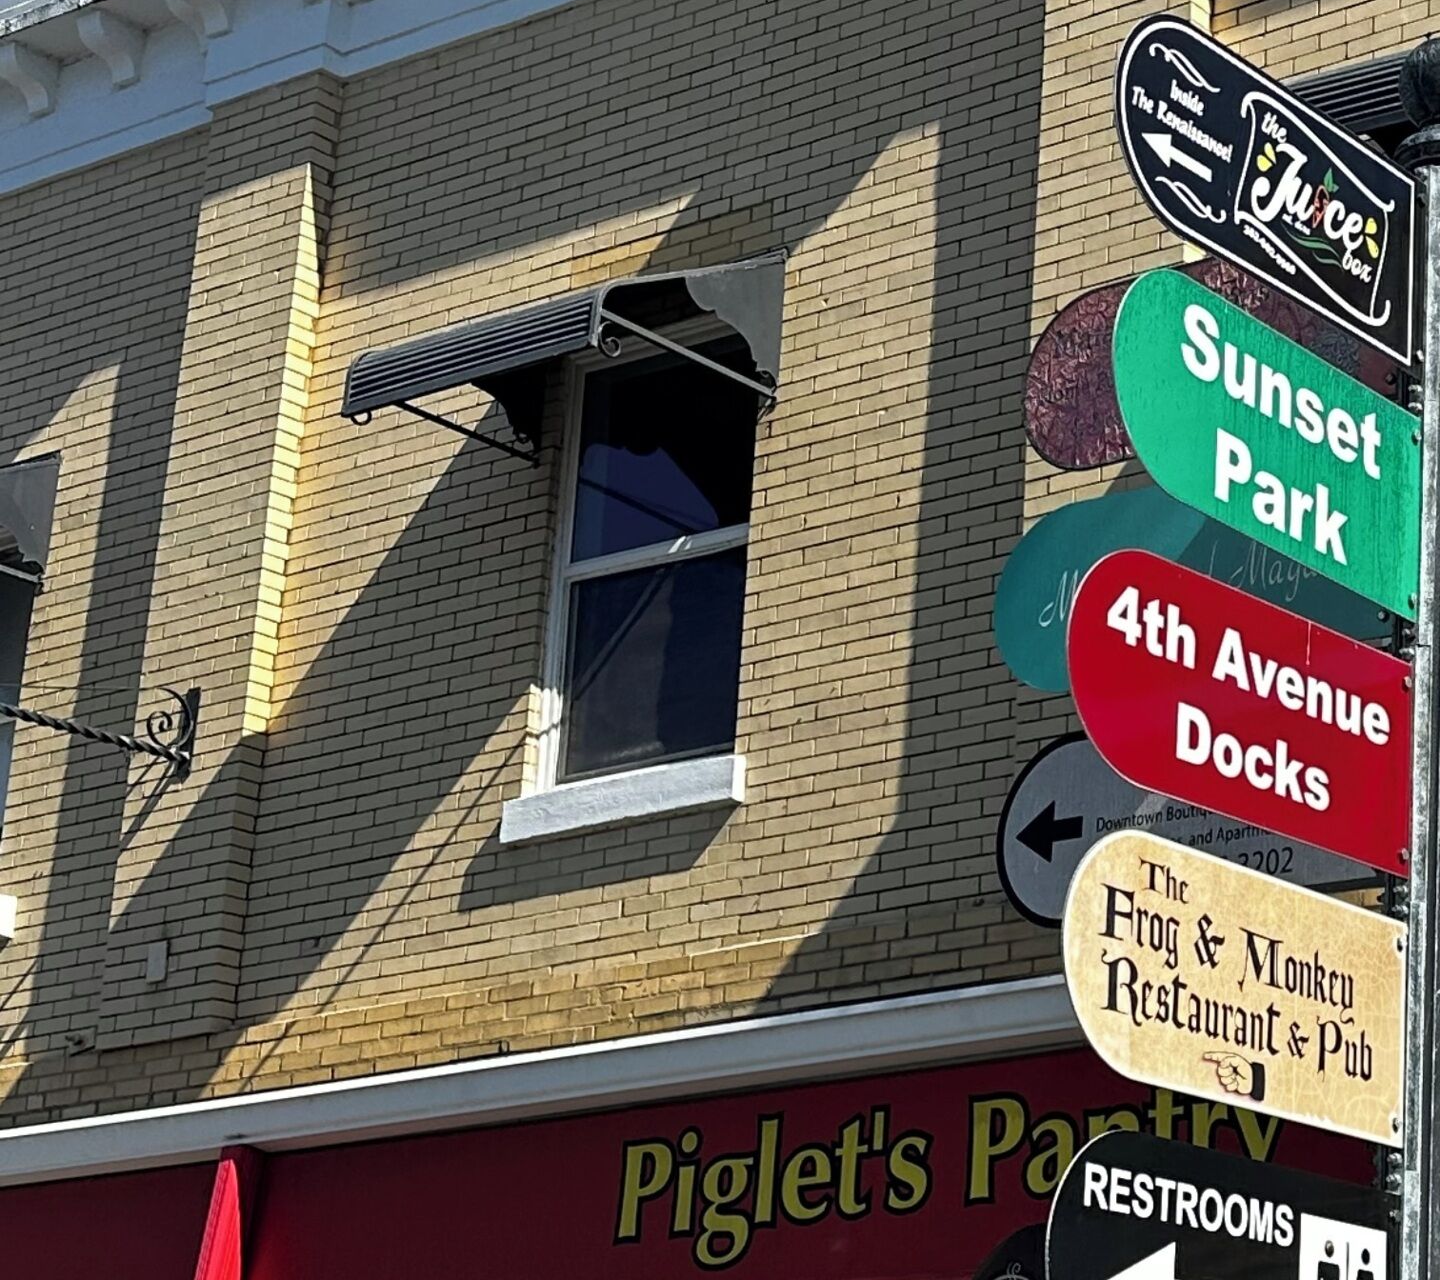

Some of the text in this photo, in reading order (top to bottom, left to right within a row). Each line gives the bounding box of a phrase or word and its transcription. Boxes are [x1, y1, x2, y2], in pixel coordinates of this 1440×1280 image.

[1131, 85, 1155, 115] The
[1169, 78, 1205, 117] Inside
[1261, 111, 1287, 143] the
[1342, 248, 1372, 284] box
[1180, 303, 1382, 480] Sunset
[1214, 428, 1348, 567] Park
[1106, 585, 1197, 669] 4th
[1212, 629, 1392, 745] Avenue
[1174, 701, 1332, 813] Docks
[1096, 810, 1163, 833] Downtown
[1188, 828, 1213, 846] and
[1138, 857, 1191, 906] The
[1097, 882, 1355, 1029] Frog & Monkey
[1100, 948, 1374, 1082] Restaurant & Pub
[618, 1108, 928, 1266] Piglet's
[1082, 1162, 1295, 1248] RESTROOMS
